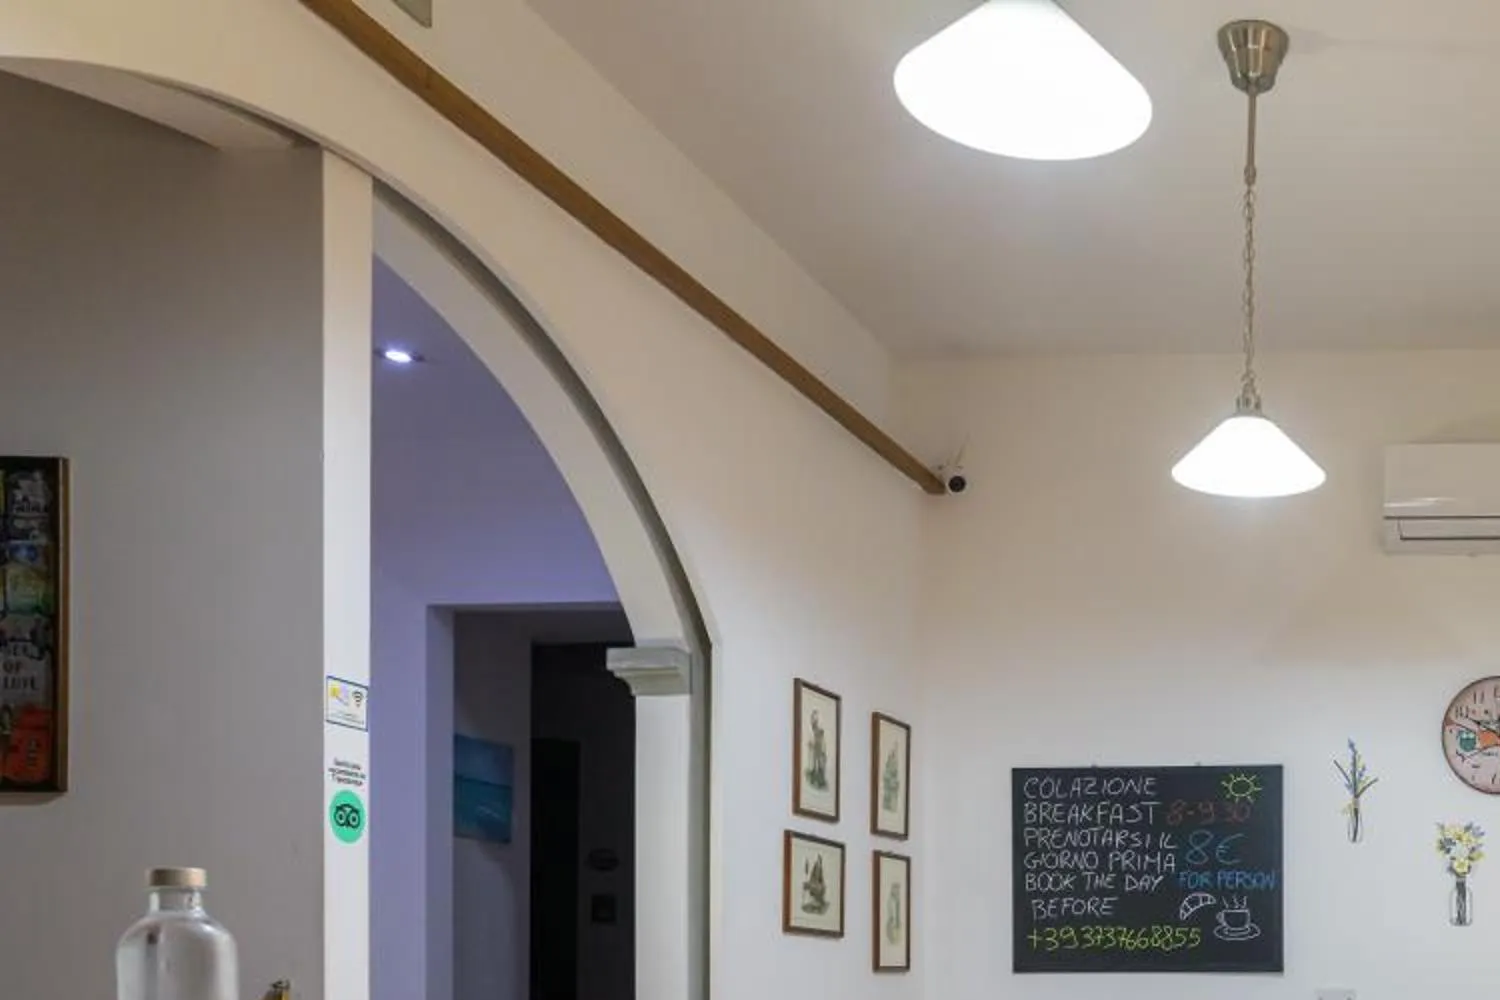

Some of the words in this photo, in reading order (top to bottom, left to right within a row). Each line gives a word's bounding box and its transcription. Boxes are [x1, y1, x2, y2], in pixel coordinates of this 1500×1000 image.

[1023, 777, 1158, 799] COLAZIONE
[1024, 801, 1162, 826] BREAKFAST
[1024, 826, 1151, 850] PRENOTARSI
[1023, 849, 1099, 870] GIORNO
[1109, 849, 1176, 874] PRIMA
[1025, 871, 1077, 892] BOOK
[1082, 871, 1117, 891] THE
[1125, 874, 1164, 892] DAY
[1177, 869, 1212, 889] FOR
[1216, 868, 1276, 891] PERSON
[1031, 896, 1119, 920] BEFORE
